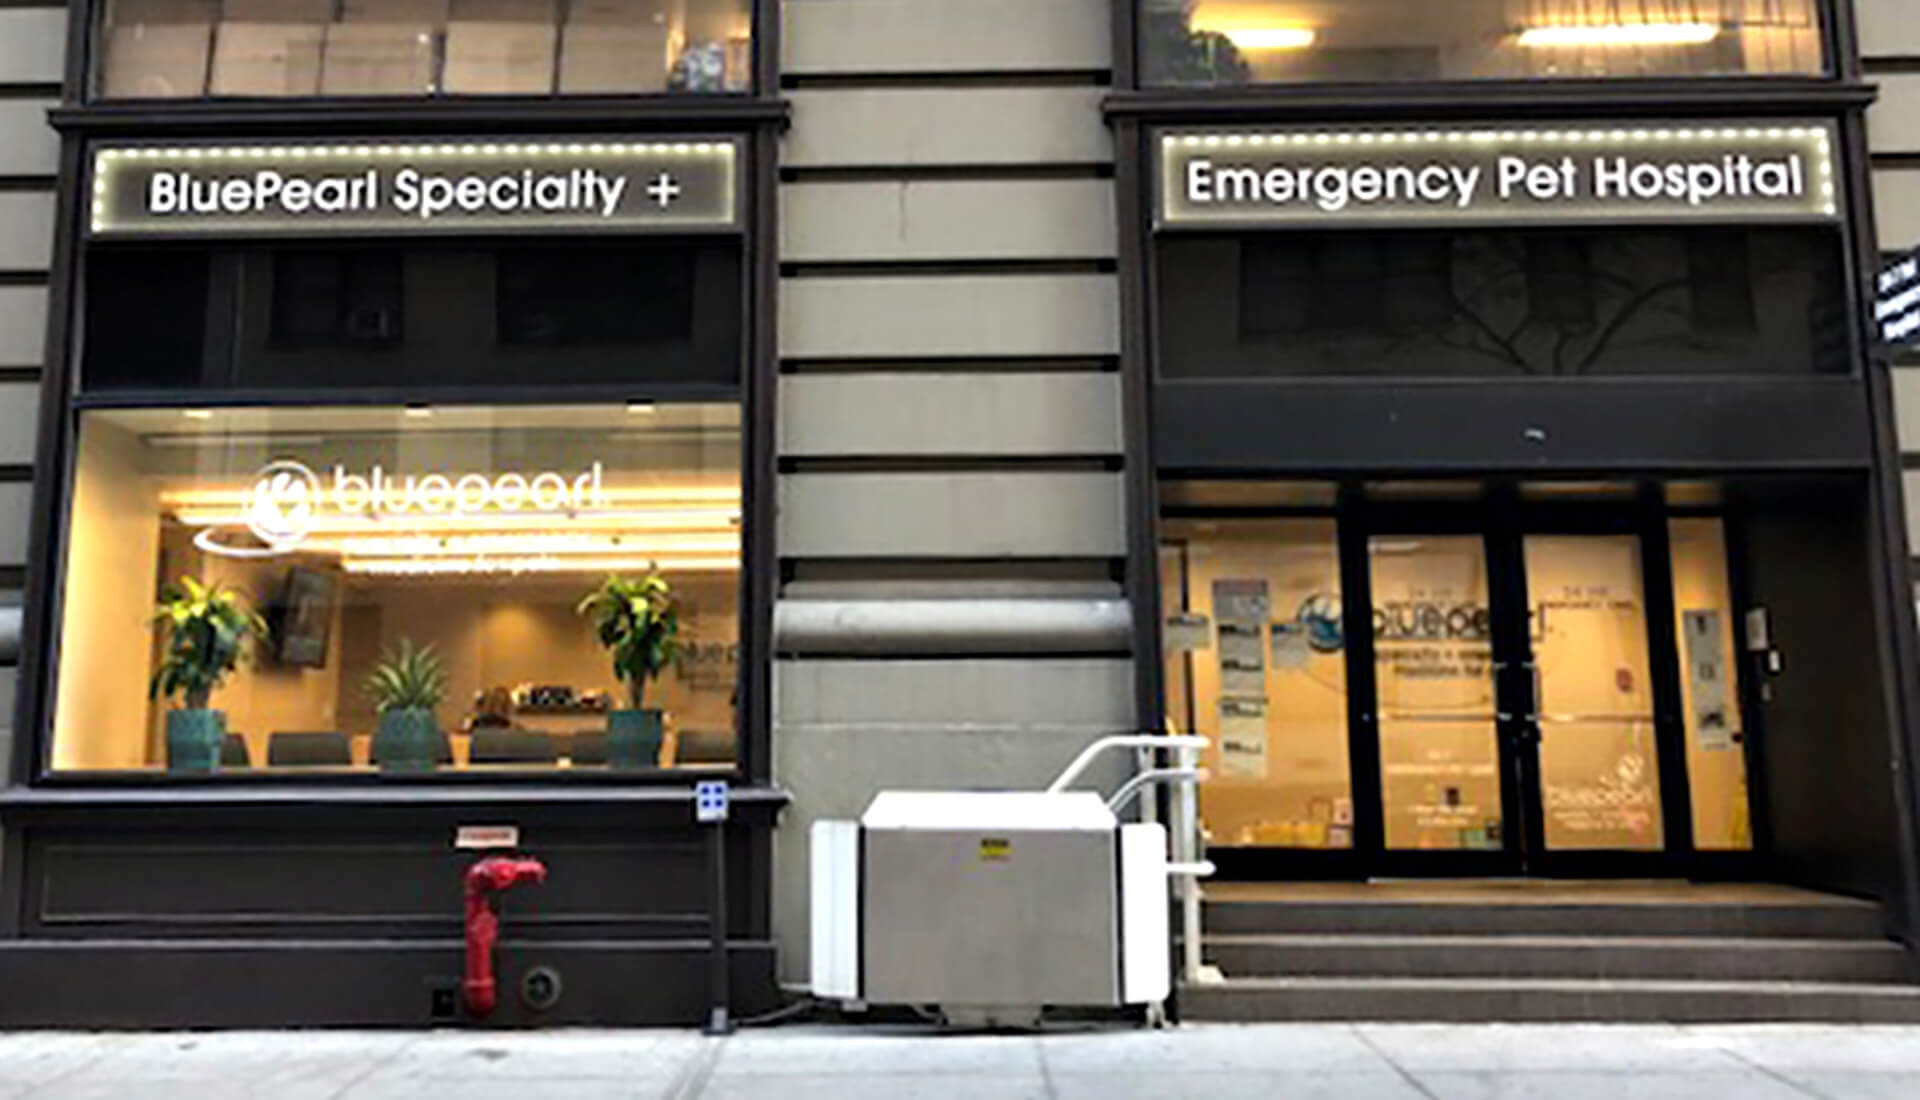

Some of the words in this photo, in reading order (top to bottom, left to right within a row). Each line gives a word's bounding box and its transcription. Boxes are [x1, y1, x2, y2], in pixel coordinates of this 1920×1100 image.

[150, 170, 377, 214] BluePearl
[393, 168, 626, 218] Specialty
[1187, 159, 1480, 211] Emergency
[1499, 157, 1576, 197] Pet
[1595, 155, 1804, 206] Hospital
[333, 461, 603, 519] bluepearl
